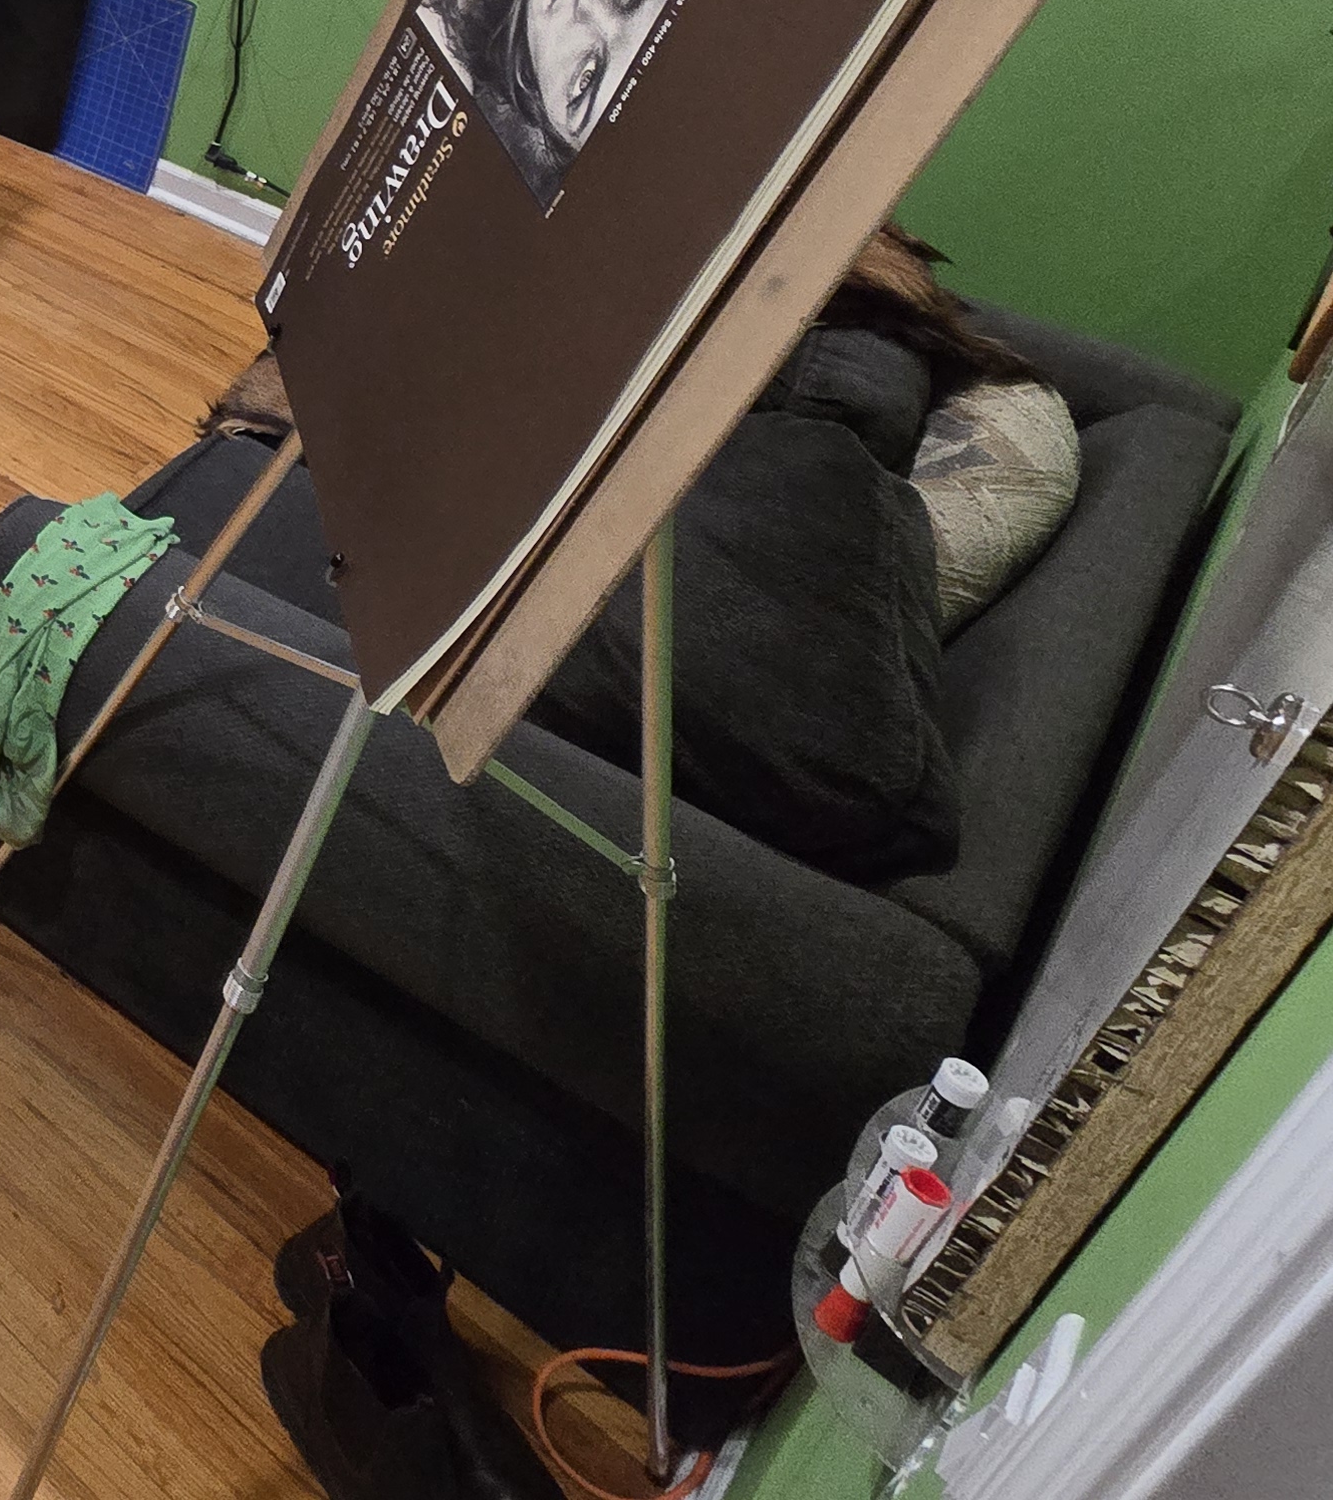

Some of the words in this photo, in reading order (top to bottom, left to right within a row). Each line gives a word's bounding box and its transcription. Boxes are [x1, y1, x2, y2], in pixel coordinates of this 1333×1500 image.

[641, 45, 655, 66] 400
[609, 102, 622, 123] 400
[341, 75, 459, 257] Drawing
[383, 136, 454, 254] Strathmore
